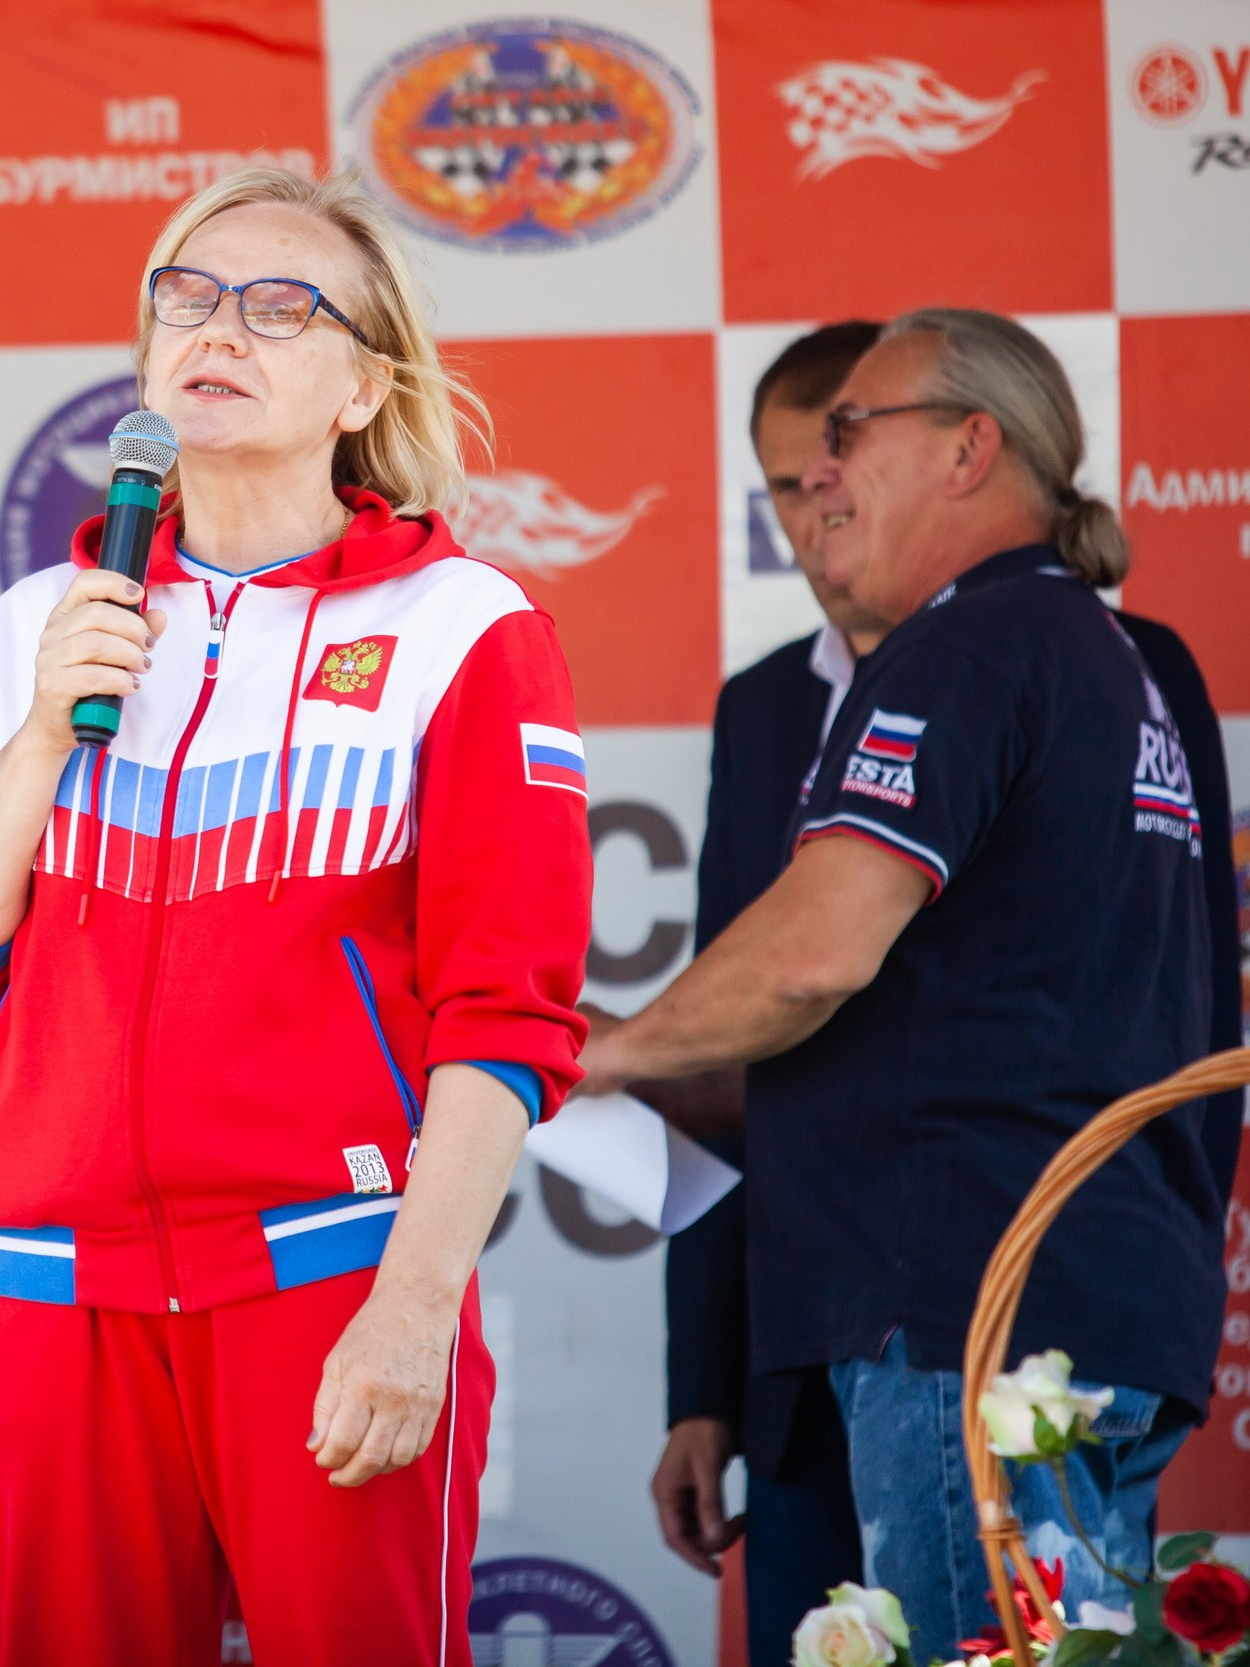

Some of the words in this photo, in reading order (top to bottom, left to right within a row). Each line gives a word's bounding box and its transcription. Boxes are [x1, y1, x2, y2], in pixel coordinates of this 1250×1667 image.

[105, 95, 180, 145] ИП
[348, 1152, 381, 1166] KAZAN
[352, 1161, 385, 1178] 2013
[355, 1174, 388, 1188] RUSSIA
